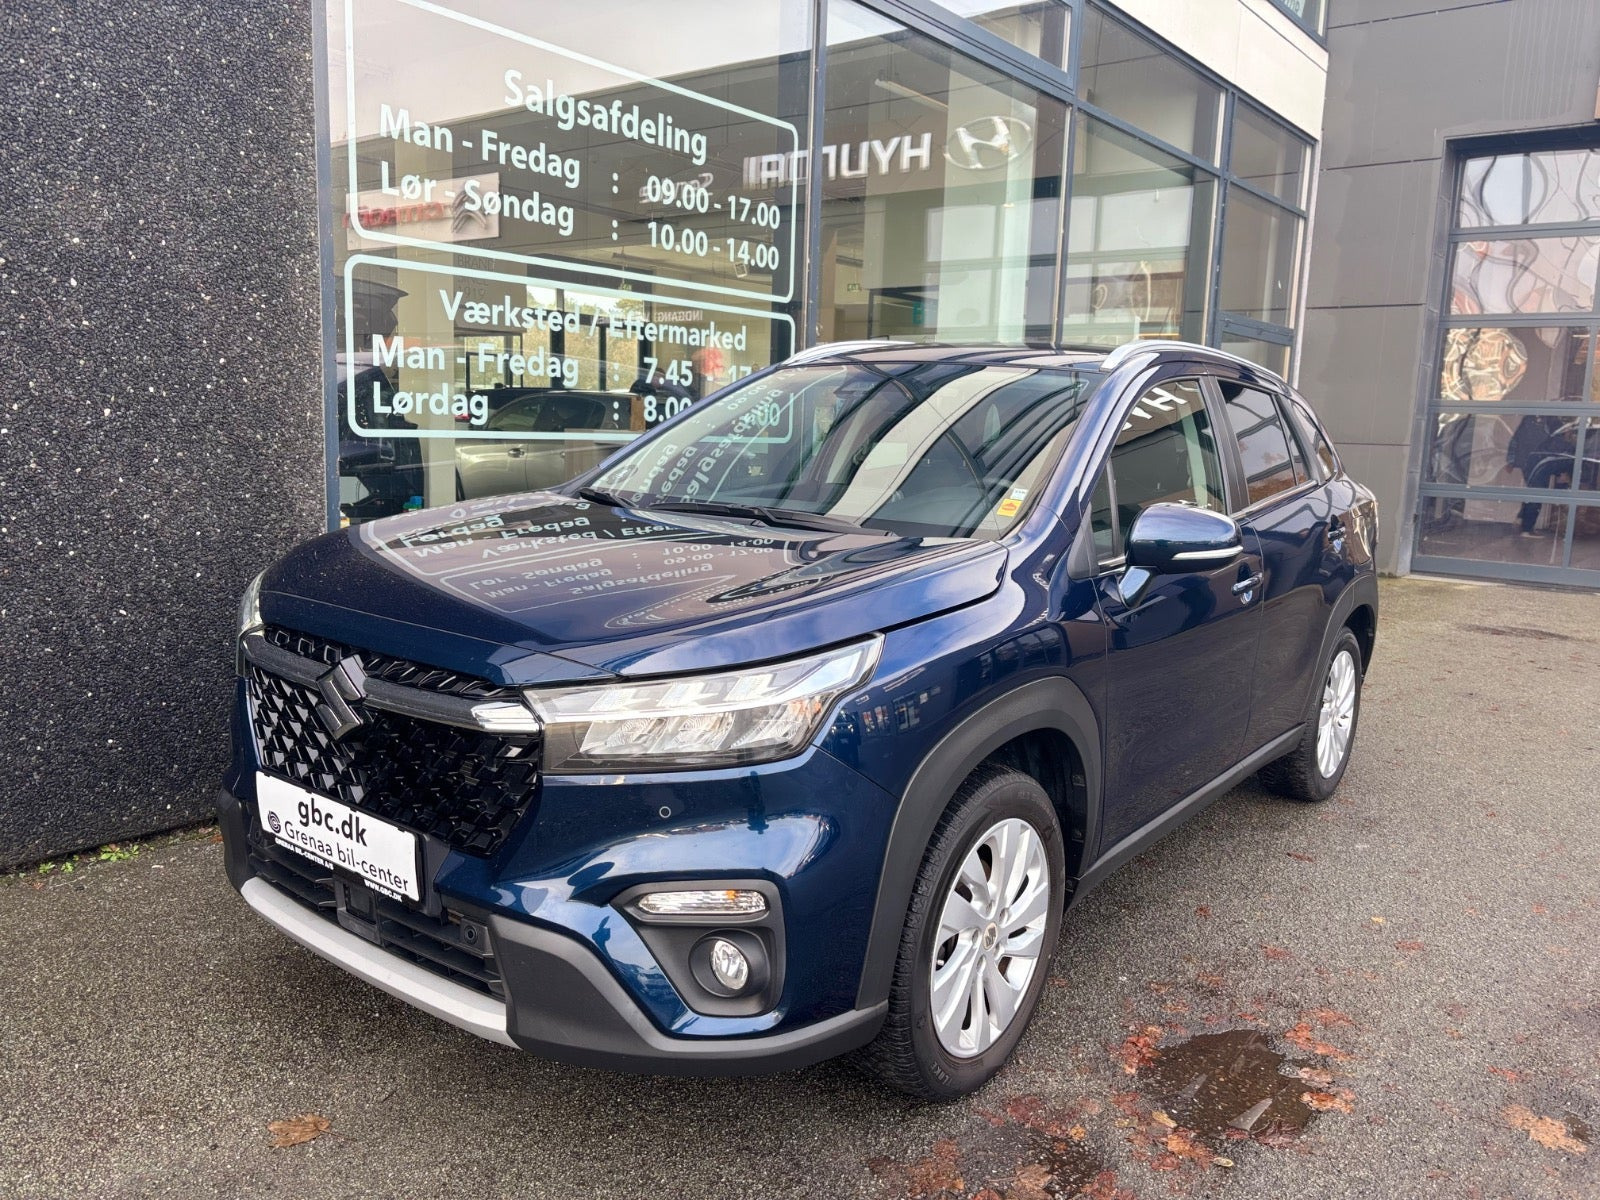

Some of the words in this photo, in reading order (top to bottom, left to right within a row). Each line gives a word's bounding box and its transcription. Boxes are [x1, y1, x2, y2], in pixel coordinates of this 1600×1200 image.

[504, 69, 707, 165] Salgsafdeling
[379, 103, 453, 152] Man
[481, 129, 580, 188] Fredag
[647, 175, 709, 213] 09.00
[728, 195, 781, 230] 17.00
[381, 160, 437, 201] Lør
[464, 179, 574, 236] Søndag
[647, 221, 709, 257] 10.00
[726, 237, 780, 271] 14.00
[439, 289, 580, 335] Værksted
[589, 304, 600, 337] /
[608, 308, 747, 352] Eftermarked
[372, 333, 446, 371] Man
[478, 343, 580, 389] Fredag
[643, 357, 694, 387] 7.45
[372, 381, 489, 426] Lørdag
[297, 798, 367, 847] gbc.dk
[284, 821, 333, 857] Grenaa
[336, 841, 409, 892] bil-center
